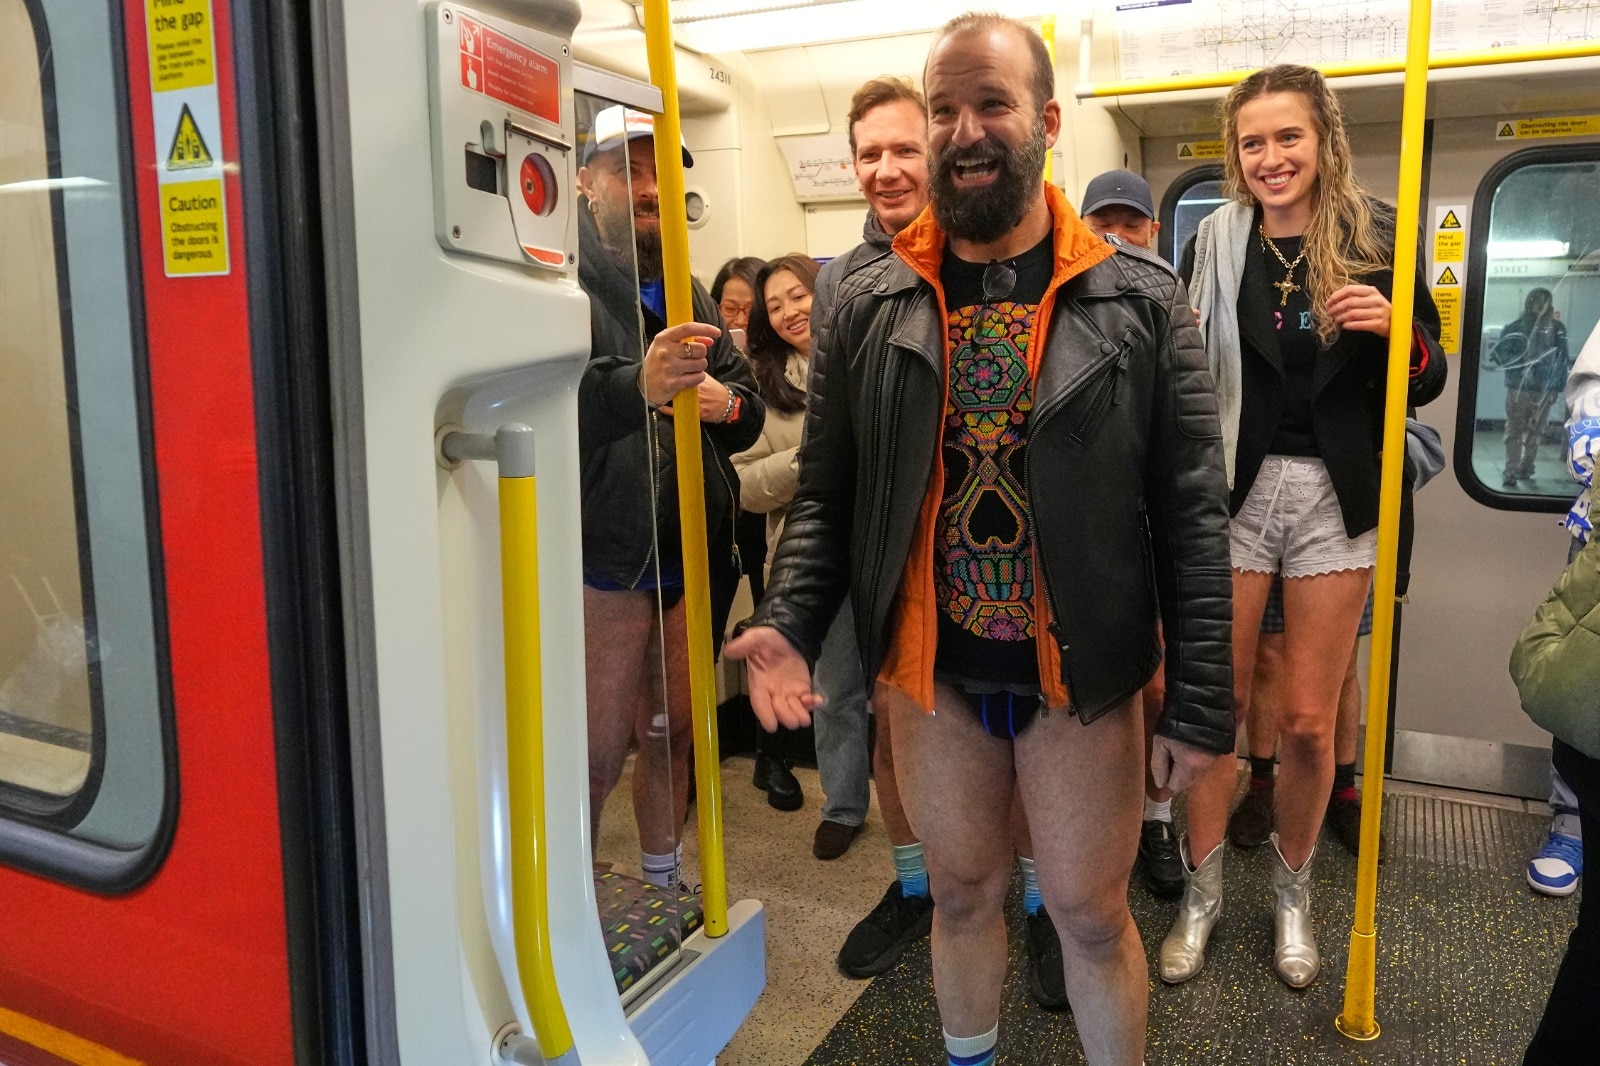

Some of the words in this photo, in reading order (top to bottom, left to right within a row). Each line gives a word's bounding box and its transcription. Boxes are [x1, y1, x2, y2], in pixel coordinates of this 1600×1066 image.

[155, 14, 176, 31] the
[181, 11, 203, 31] gap
[486, 37, 527, 67] Emergency
[528, 59, 548, 75] alarm
[710, 67, 731, 85] 24311
[1541, 126, 1572, 134] dangerous
[169, 195, 217, 212] Caution
[170, 221, 218, 233] Obstructing
[171, 237, 185, 246] the
[187, 235, 209, 245] doors
[211, 234, 219, 244] is
[172, 250, 212, 261] dangerous
[1494, 264, 1529, 274] STREET
[1299, 311, 1311, 330] E
